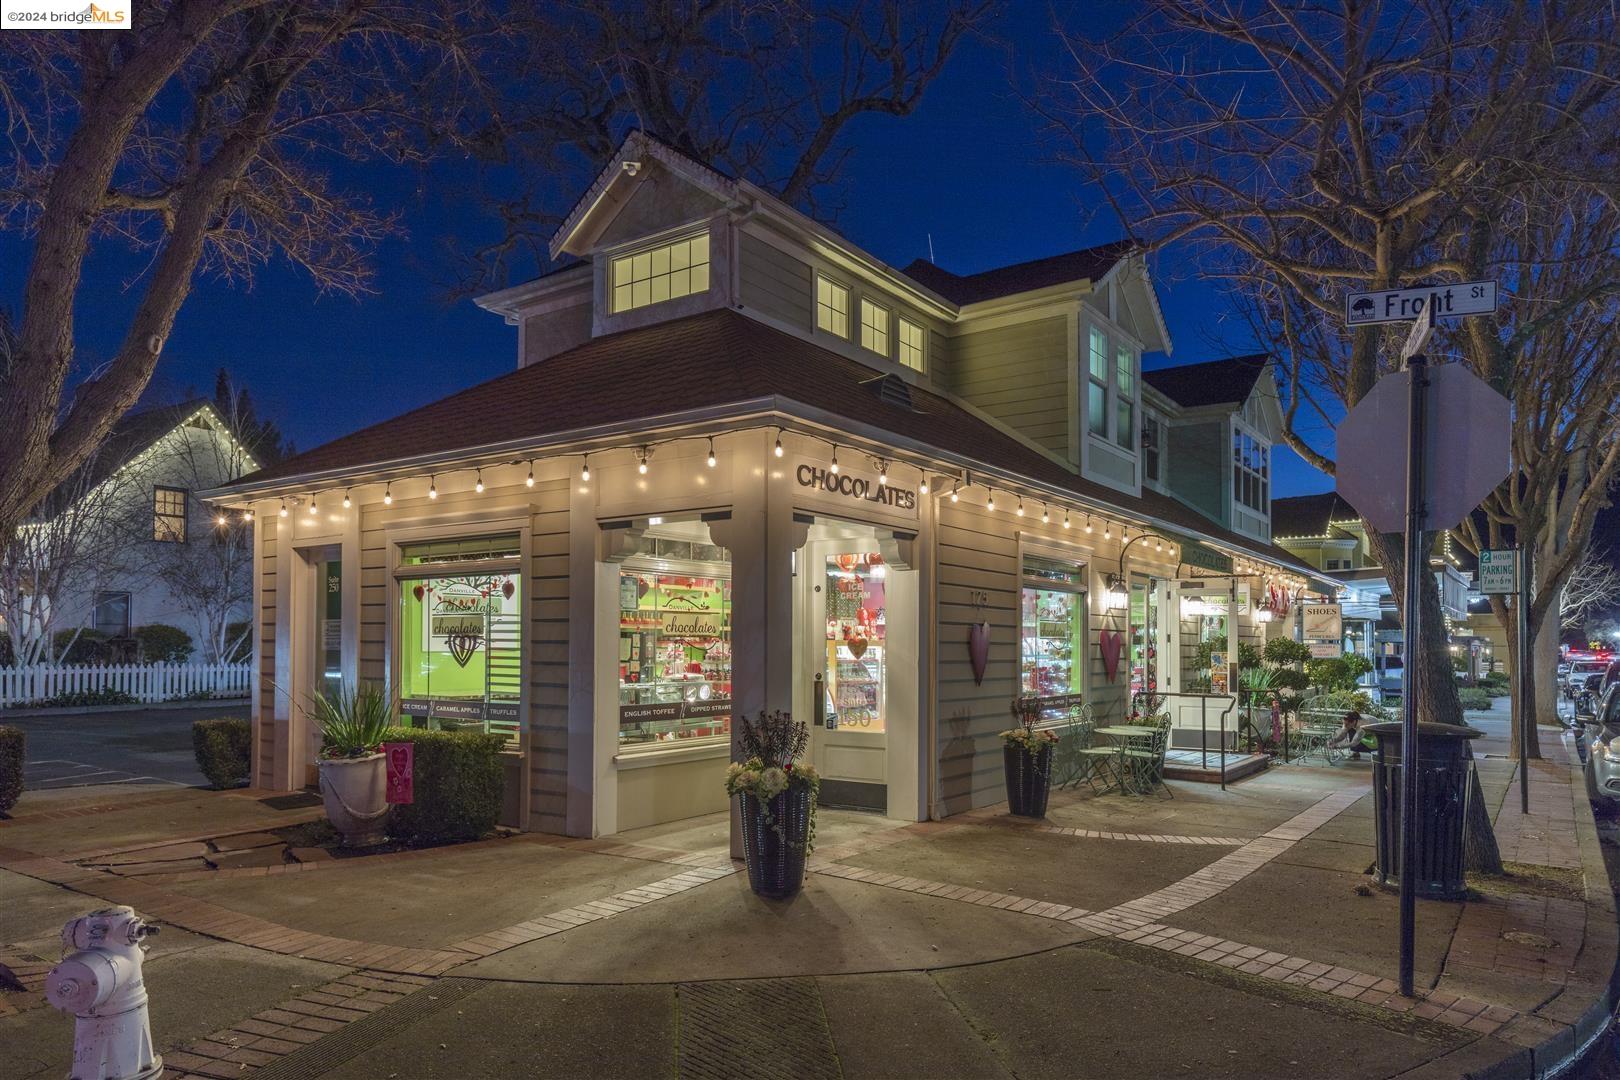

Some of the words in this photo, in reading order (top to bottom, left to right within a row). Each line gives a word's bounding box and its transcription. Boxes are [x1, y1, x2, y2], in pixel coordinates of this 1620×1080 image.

[1385, 289, 1454, 317] Frot
[1471, 286, 1485, 299] St
[796, 464, 916, 510] CHOCOLATES
[1482, 552, 1490, 563] 2
[1482, 565, 1513, 575] PARKING
[848, 581, 863, 591] ICE
[841, 592, 871, 600] CREAM
[433, 617, 481, 635] chocolates
[665, 615, 717, 634] chocolates
[624, 710, 651, 718] ENGLISH
[690, 705, 711, 713] DIPPED
